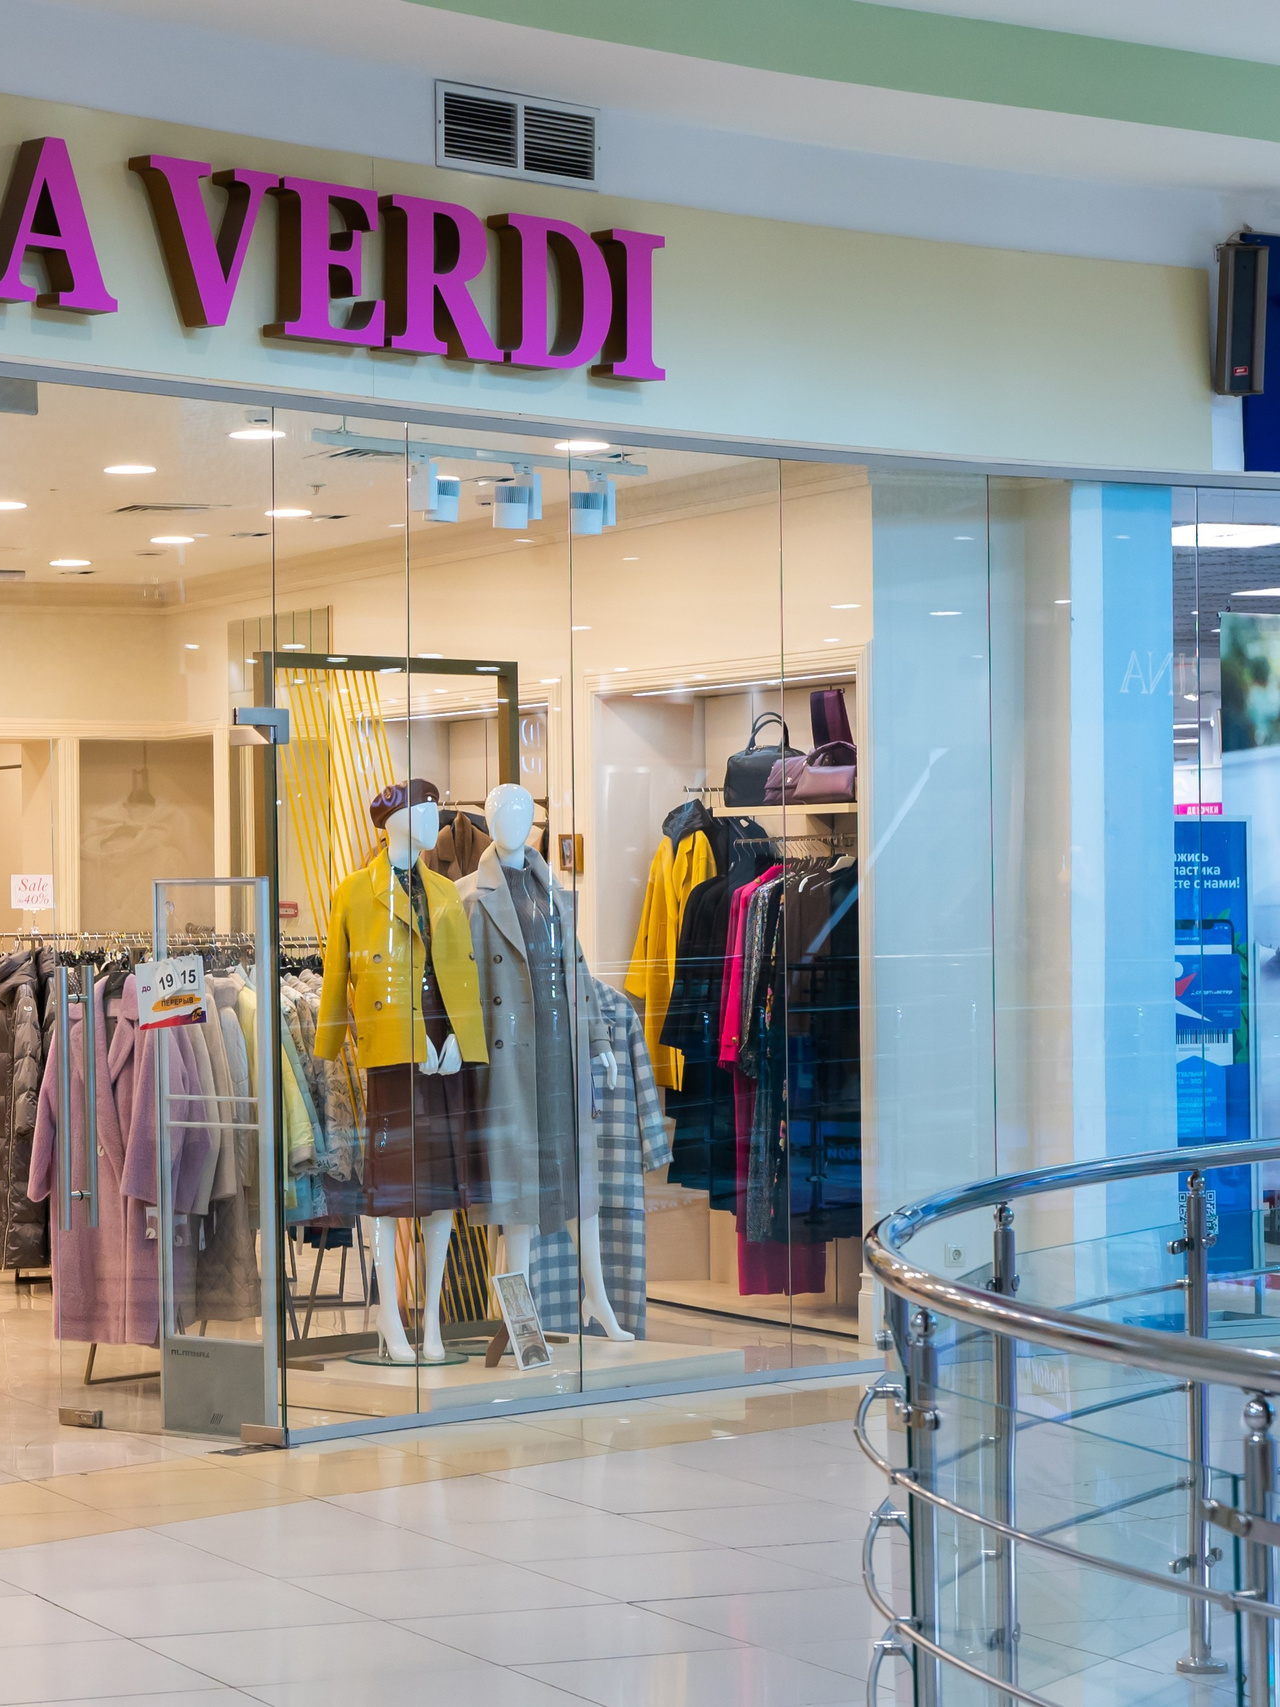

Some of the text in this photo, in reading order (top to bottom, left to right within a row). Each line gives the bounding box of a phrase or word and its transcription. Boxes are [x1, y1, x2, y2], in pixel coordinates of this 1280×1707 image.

[129, 154, 666, 381] VERDI
[18, 877, 49, 892] Sale
[1193, 880, 1201, 889] с
[1204, 877, 1240, 889] нами!
[159, 974, 174, 990] 19
[181, 970, 197, 985] 15
[161, 997, 194, 1007] ПЕРЕРЫВ
